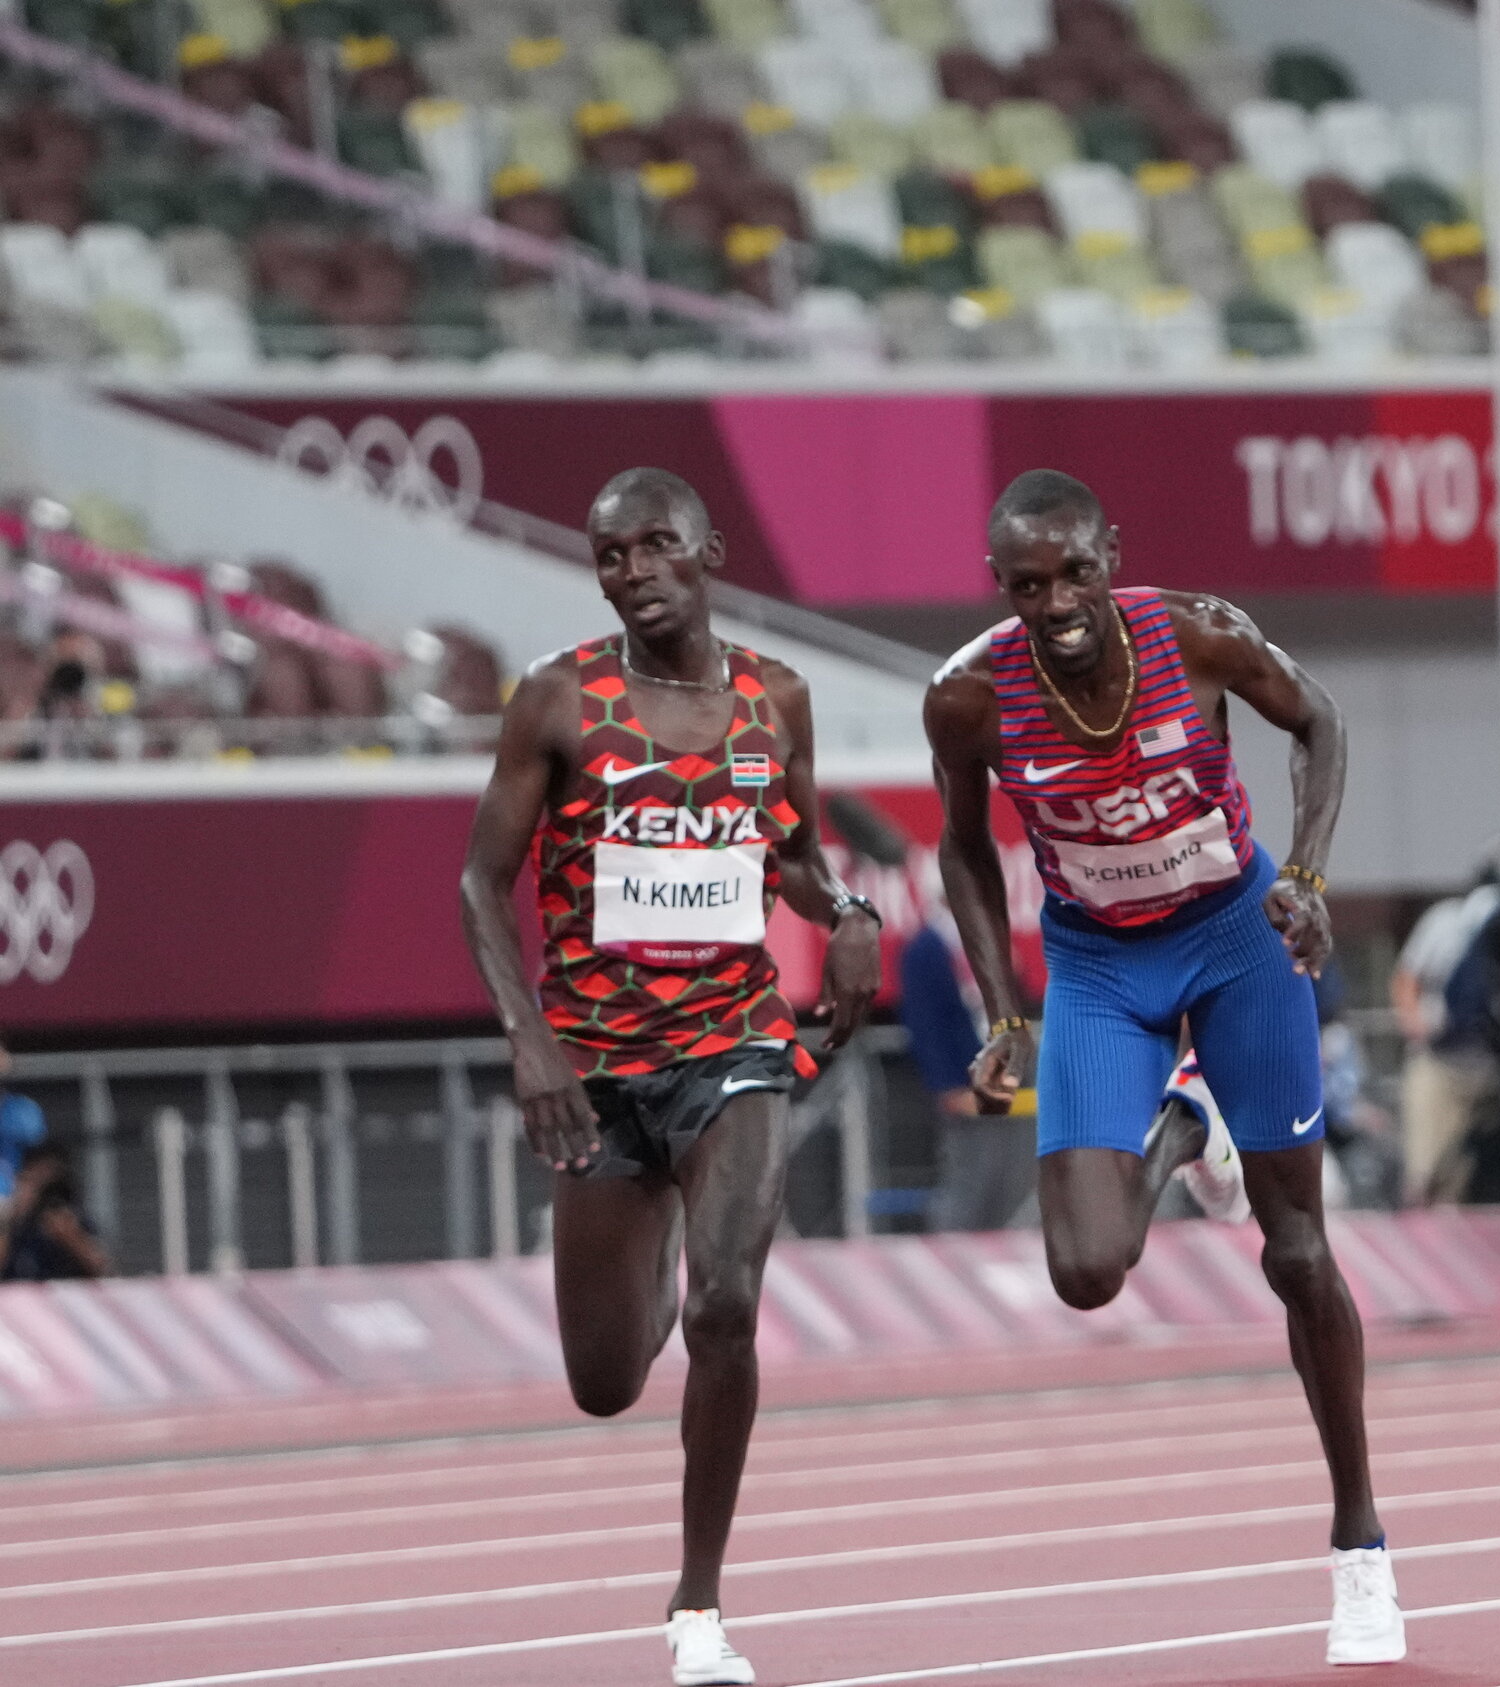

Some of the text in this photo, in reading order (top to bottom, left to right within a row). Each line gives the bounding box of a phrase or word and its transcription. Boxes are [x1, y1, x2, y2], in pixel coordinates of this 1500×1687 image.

[1234, 433, 1480, 547] TOKYO
[602, 806, 763, 842] KENYA
[1084, 841, 1202, 882] P.CHELIMO
[623, 876, 741, 908] N.KIMELI
